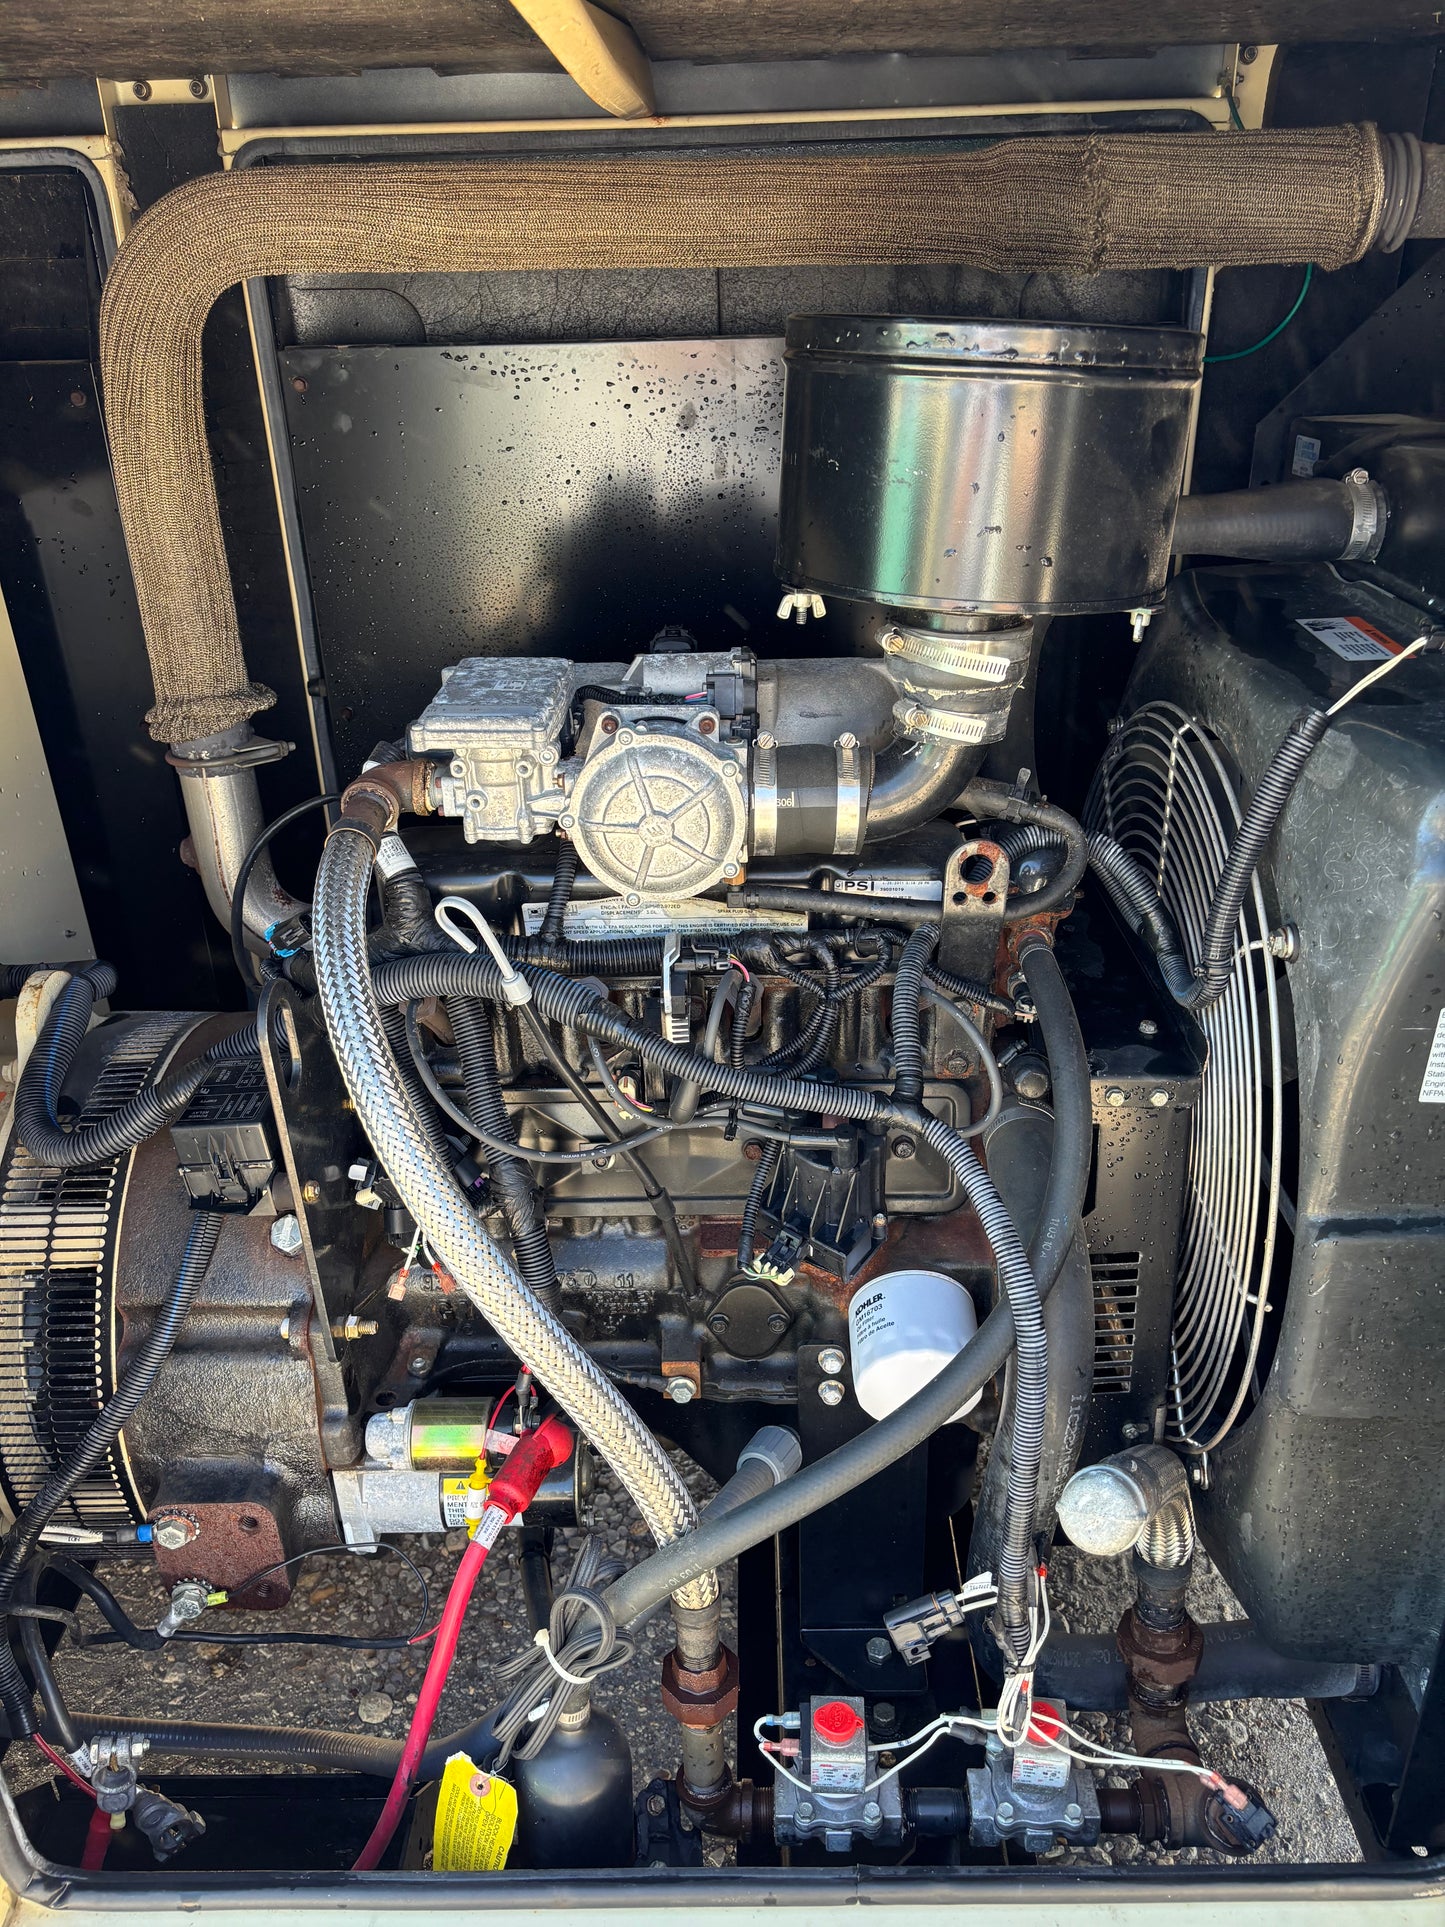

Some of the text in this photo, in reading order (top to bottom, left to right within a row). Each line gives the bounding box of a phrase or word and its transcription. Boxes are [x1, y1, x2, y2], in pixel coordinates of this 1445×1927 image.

[844, 881, 874, 891] PSI
[856, 1304, 883, 1326] GM16703
[872, 1317, 885, 1326] huile
[876, 1321, 894, 1331] Aceite
[492, 1817, 502, 1838] BLOCK
